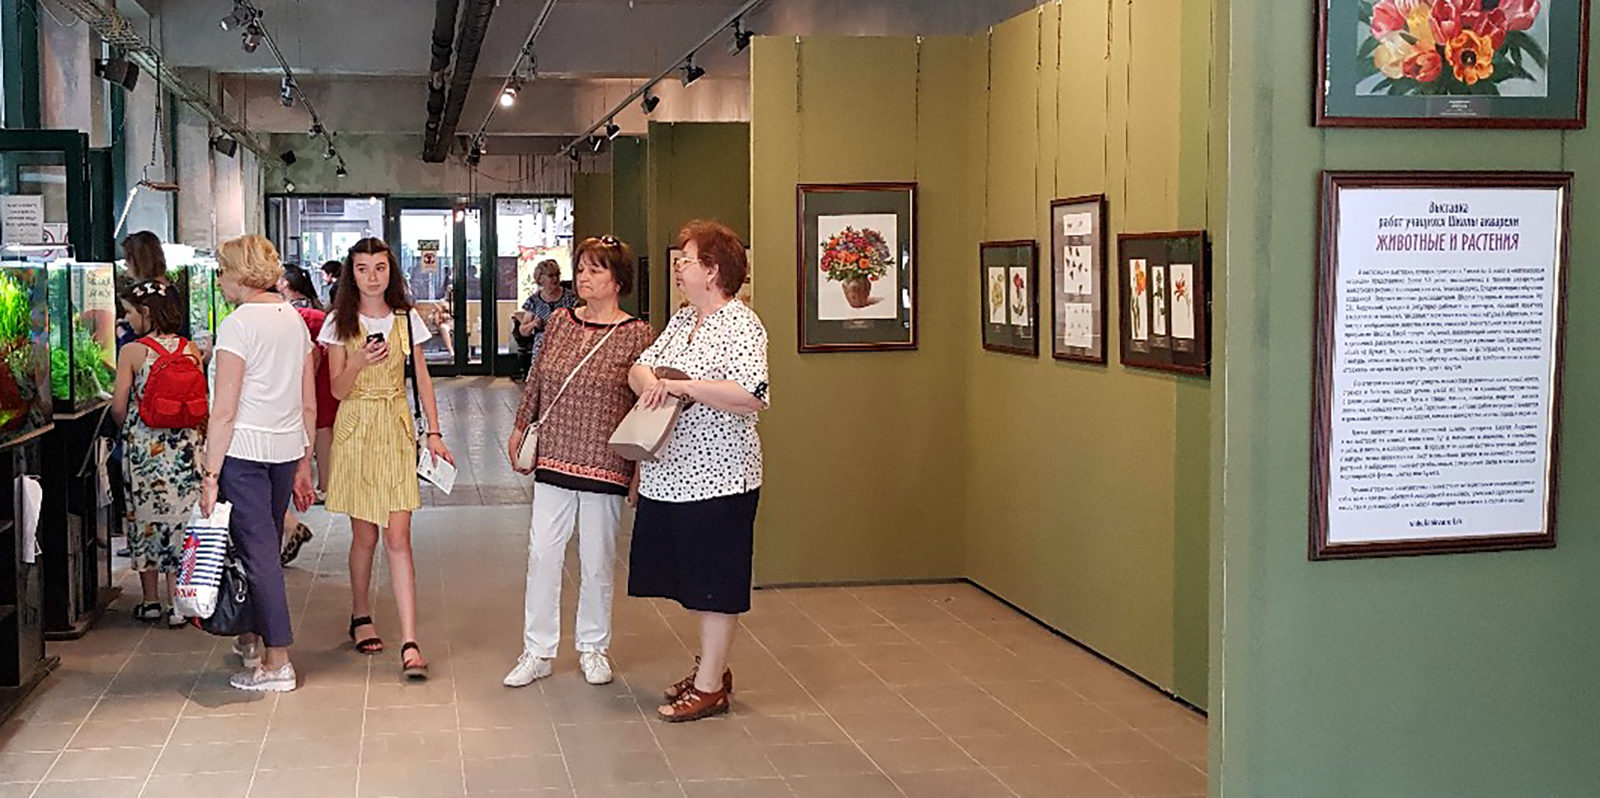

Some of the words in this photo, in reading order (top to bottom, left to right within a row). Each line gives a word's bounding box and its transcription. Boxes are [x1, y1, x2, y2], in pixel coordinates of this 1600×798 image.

[1428, 201, 1469, 214] Выставка
[1378, 216, 1403, 229] работ
[1405, 217, 1445, 230] учащихся
[1448, 215, 1478, 227] Школы
[1480, 217, 1520, 230] акварели
[1376, 233, 1447, 251] ЖИВОТНЫЕ
[1450, 233, 1458, 251] И
[1461, 233, 1520, 251] РАСТЕНИЯ
